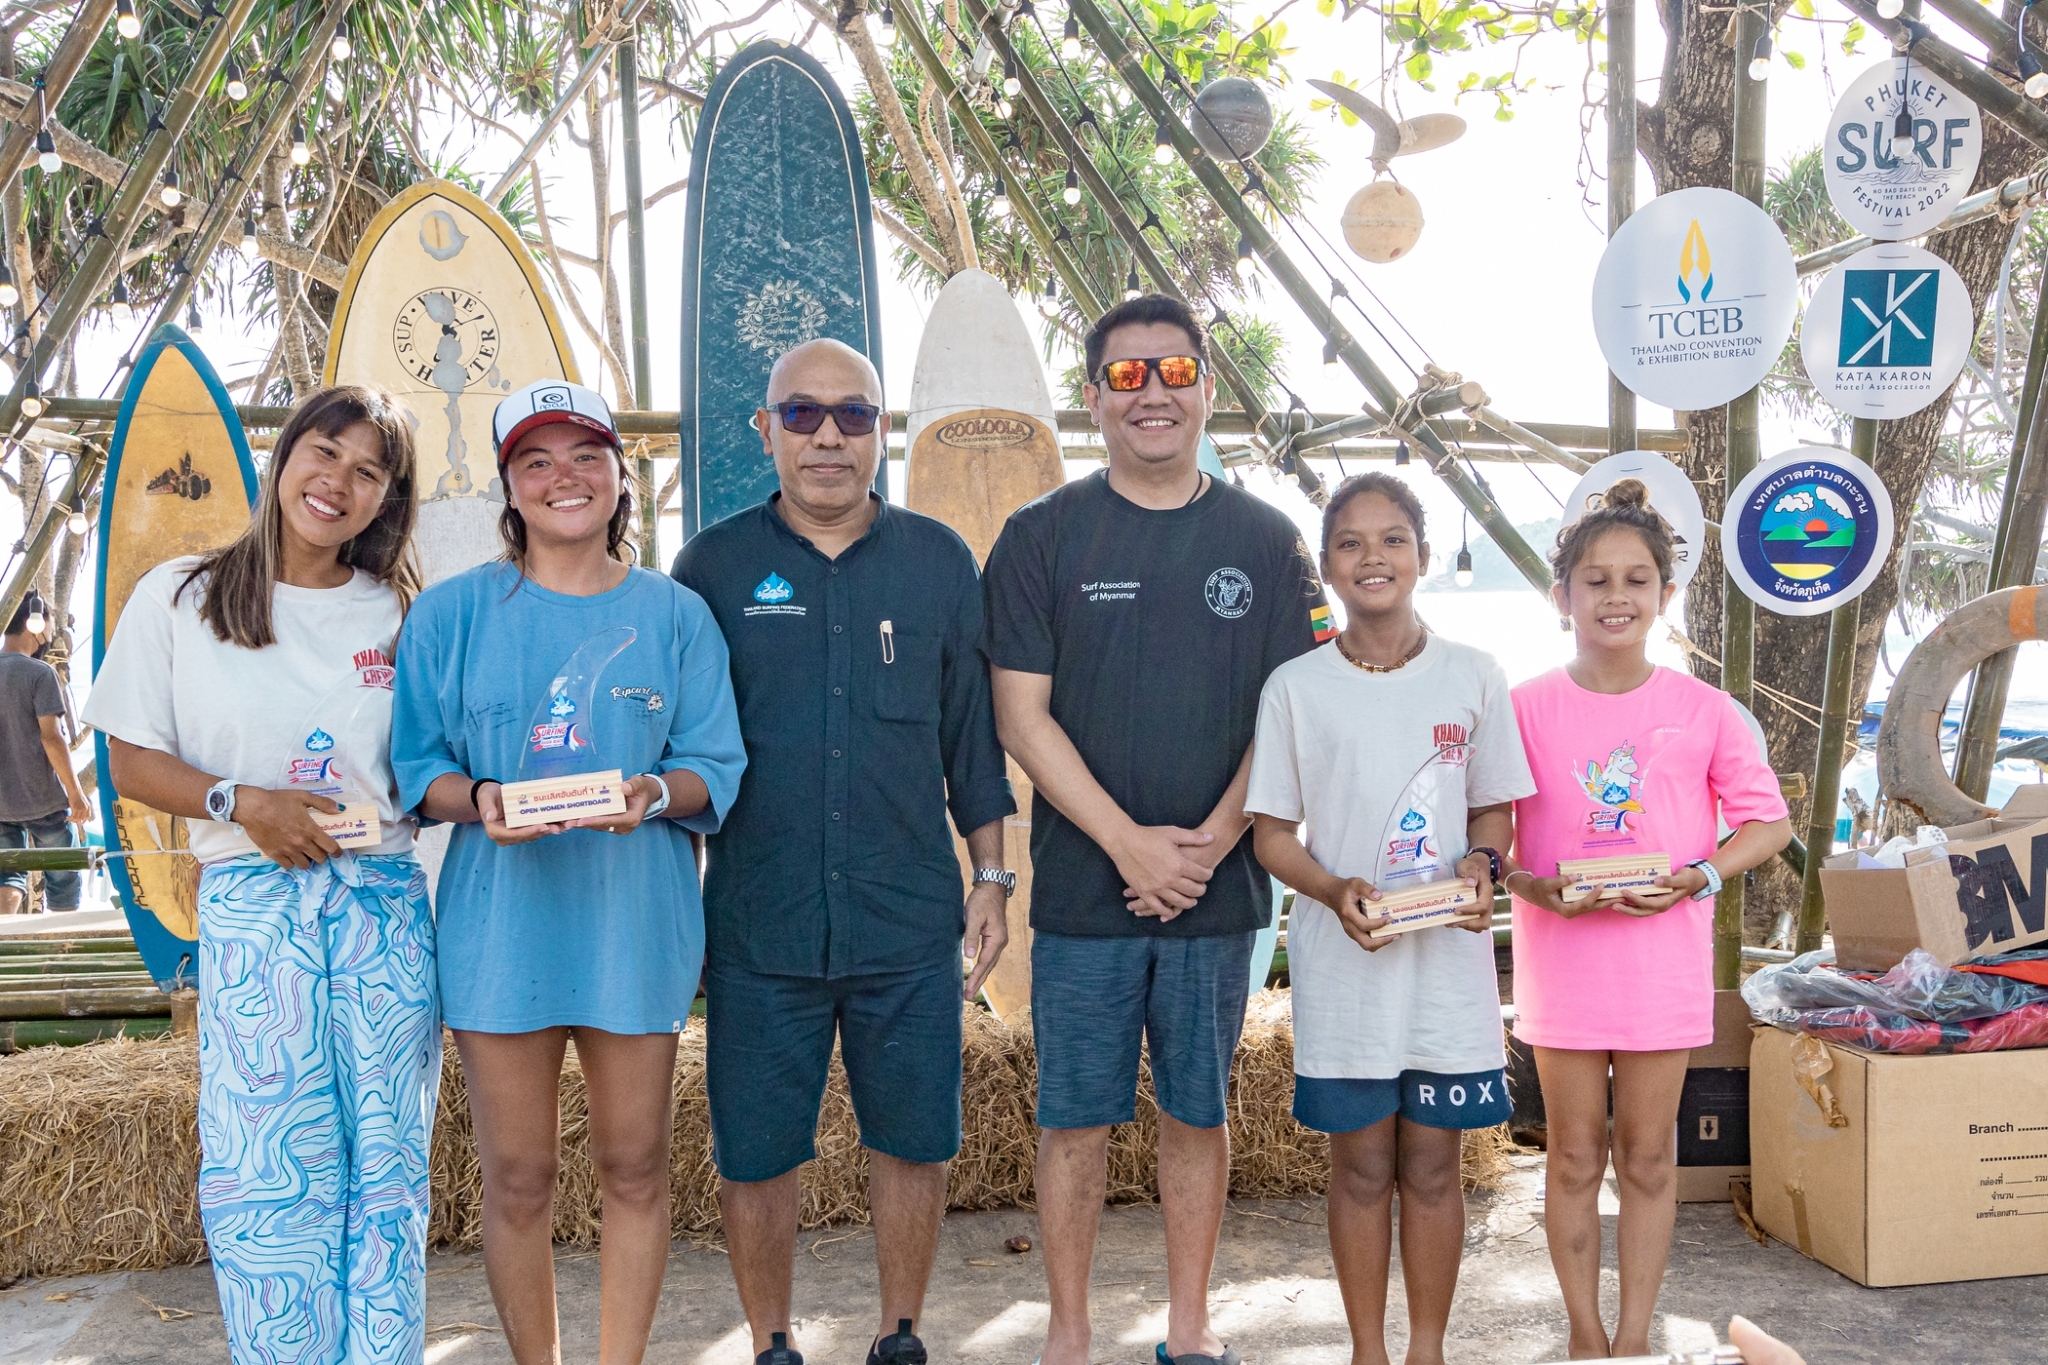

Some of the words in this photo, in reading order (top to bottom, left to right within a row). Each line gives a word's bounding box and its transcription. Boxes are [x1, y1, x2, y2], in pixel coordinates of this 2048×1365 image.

[1865, 79, 1948, 112] PHUKET
[1836, 118, 1971, 173] SURF
[1853, 186, 1911, 218] FESTIVAL
[1917, 182, 1950, 212] 2022
[1648, 307, 1743, 339] TCEB
[397, 315, 413, 353] SUP
[1631, 343, 1686, 356] THAILAND
[1689, 336, 1762, 351] CONVENTION
[416, 328, 496, 382] HTER
[1637, 357, 1644, 366] &
[1649, 351, 1710, 365] EXHIBITION
[1713, 348, 1756, 359] BUREAU
[1836, 372, 1873, 381] KATA
[1880, 371, 1932, 381] KARON
[944, 419, 1027, 440] COOLOOLA
[1753, 465, 1868, 514] เทศบาลตำบลกะรน
[1081, 582, 1098, 592] Surf
[1099, 581, 1141, 589] Association
[1775, 577, 1831, 600] จังหวัดภูเก็ต
[1089, 593, 1098, 601] of
[1100, 592, 1136, 601] Myanmar
[531, 725, 567, 741] SURFING
[288, 759, 323, 774] SURFING
[519, 807, 538, 815] OPEN
[540, 803, 565, 812] WOMEN
[566, 798, 611, 809] SHORTBOARD
[1587, 811, 1618, 825] SURFING
[1387, 840, 1418, 856] SURFING
[1575, 884, 1592, 892] OPEN
[1618, 880, 1655, 888] SHORTBOAR
[1400, 914, 1424, 923] WOMEN
[1969, 1122, 2014, 1135] Branch
[1991, 1191, 2014, 1200] จำนวน
